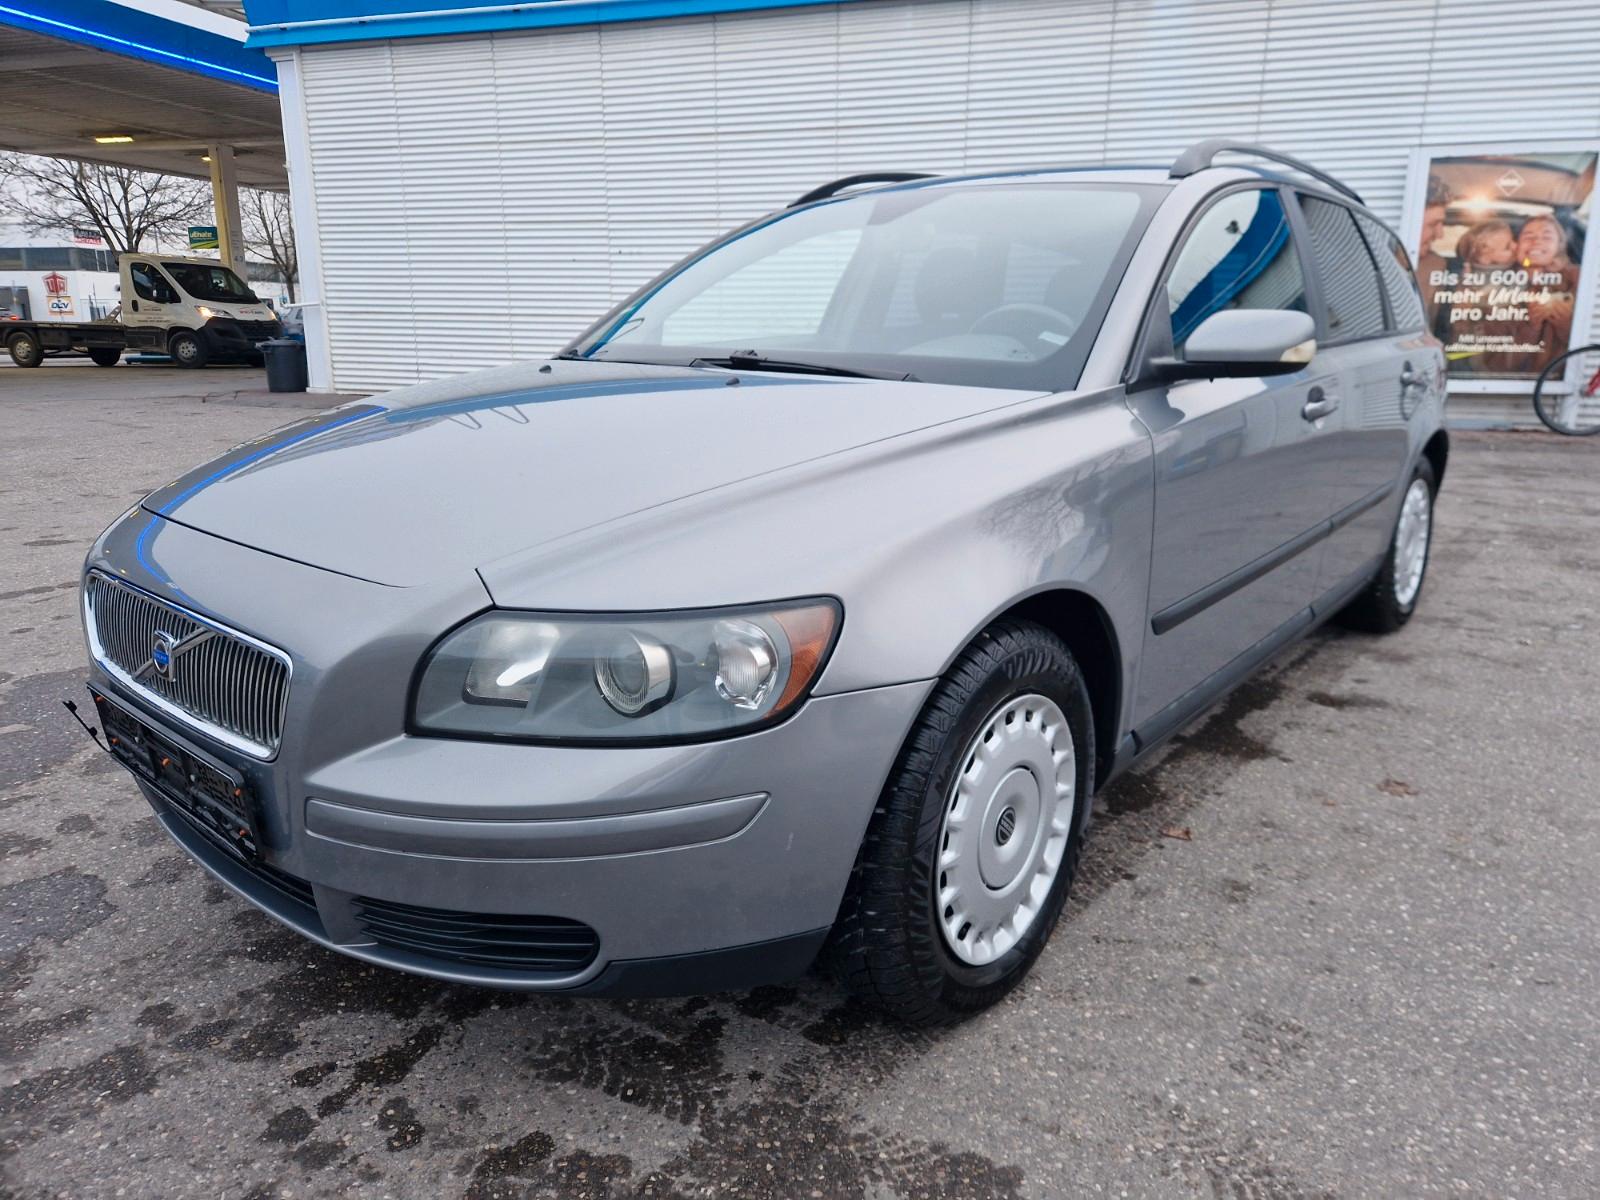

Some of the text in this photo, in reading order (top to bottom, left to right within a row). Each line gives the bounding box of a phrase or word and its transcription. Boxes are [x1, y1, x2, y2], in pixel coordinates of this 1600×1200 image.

[1429, 270, 1562, 286] Bis zu 600 km
[1434, 286, 1551, 305] mehr Urlaub
[1450, 305, 1530, 323] pro Jahr.
